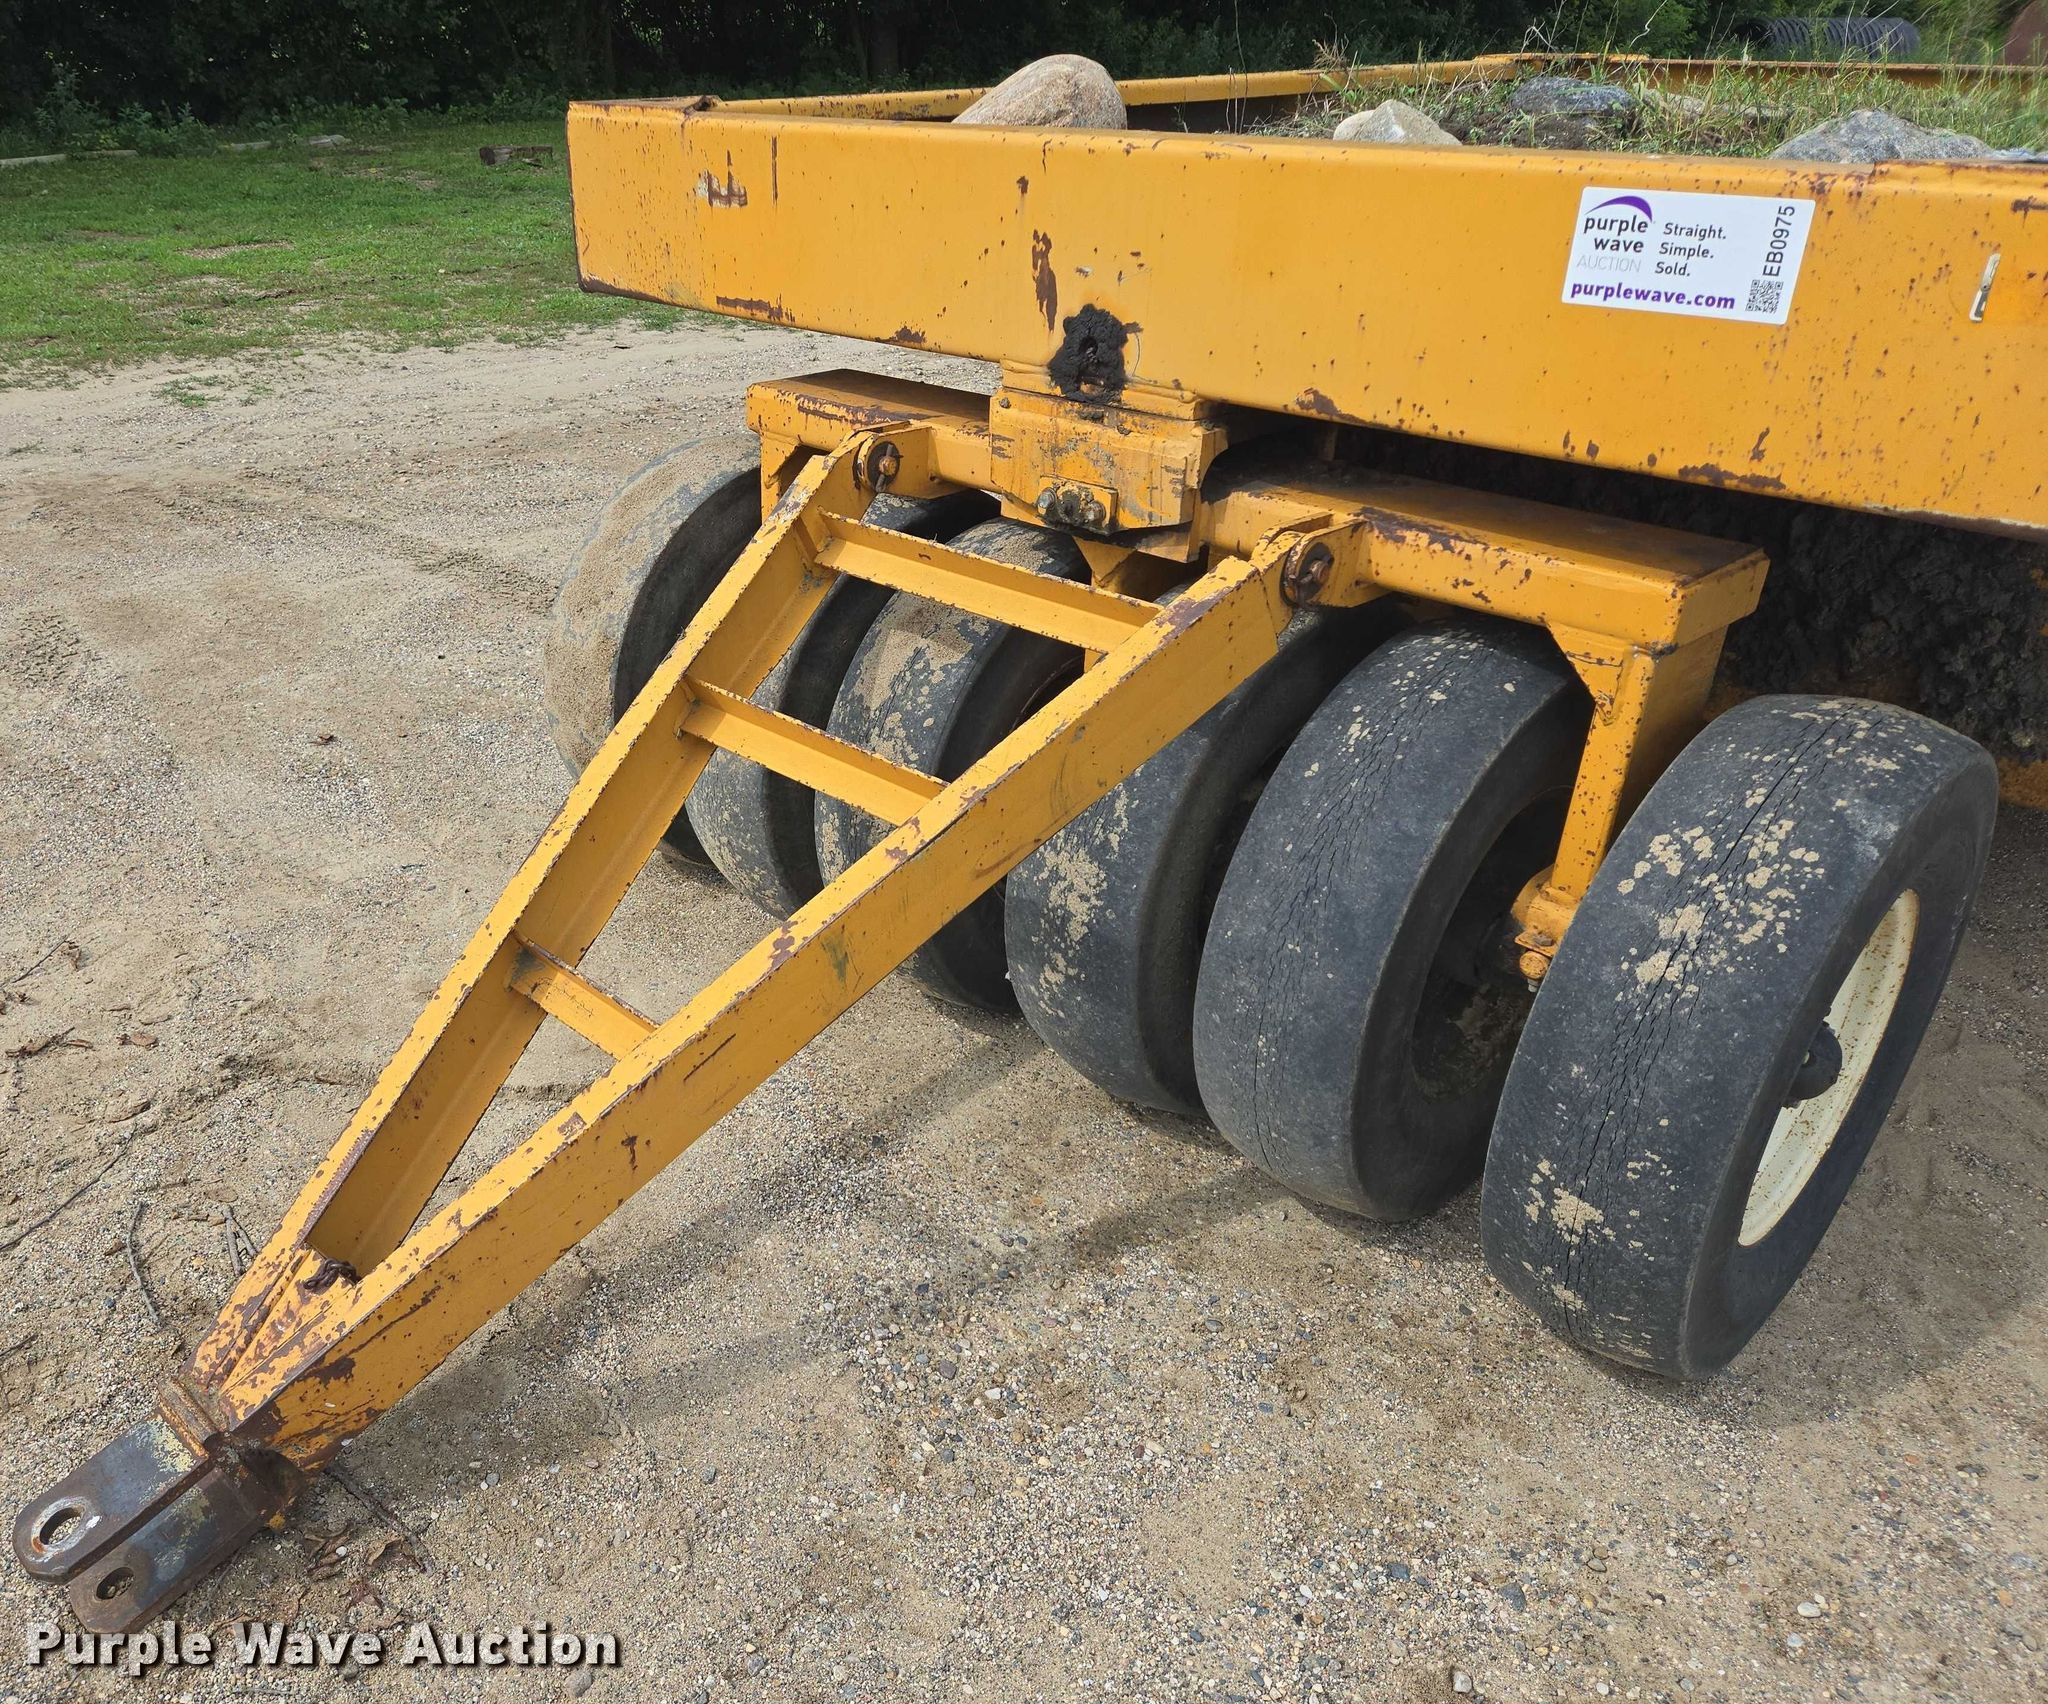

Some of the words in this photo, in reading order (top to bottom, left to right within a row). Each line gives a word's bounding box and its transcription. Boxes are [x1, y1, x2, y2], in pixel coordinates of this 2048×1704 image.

[1583, 215, 1648, 234] purple
[1663, 222, 1727, 240] Straight.
[1593, 237, 1644, 253] wave
[1763, 205, 1796, 277] EB0975
[1659, 242, 1714, 259] Simple.
[1576, 254, 1642, 273] AUCTION
[1655, 261, 1691, 277] Sold.
[1571, 282, 1736, 309] purplewave.com
